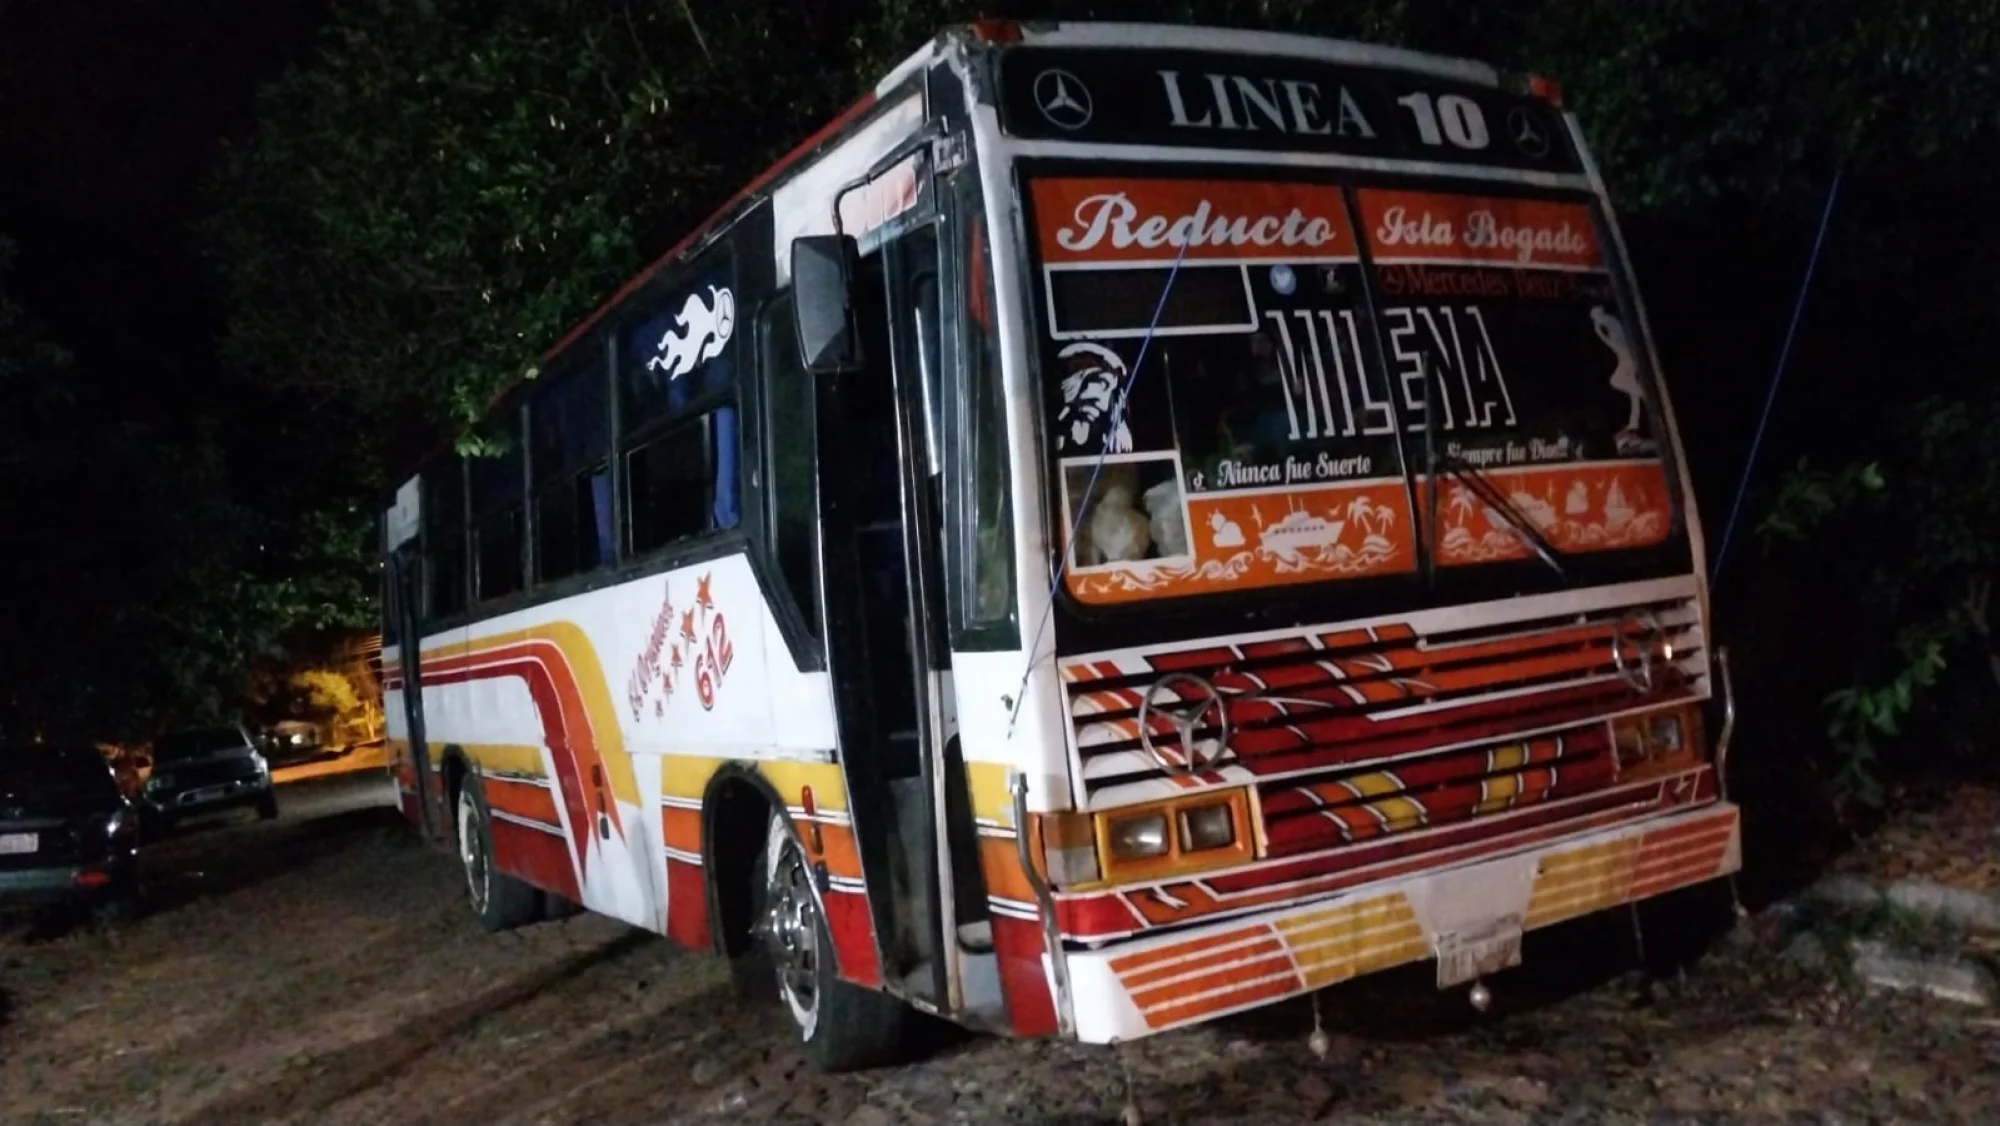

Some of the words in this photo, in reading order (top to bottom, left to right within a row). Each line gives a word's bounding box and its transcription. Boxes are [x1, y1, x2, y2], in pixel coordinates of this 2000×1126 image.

[1158, 70, 1377, 140] LINEA
[1397, 91, 1491, 150] 10
[1056, 190, 1336, 252] Reducto
[1376, 204, 1456, 246] Isla
[1463, 209, 1587, 263] Bogado
[1265, 304, 1518, 441] MILENA
[1217, 459, 1281, 487] Nunca
[1285, 454, 1312, 485] fue
[1316, 451, 1372, 478] Suerte
[694, 612, 734, 712] 612
